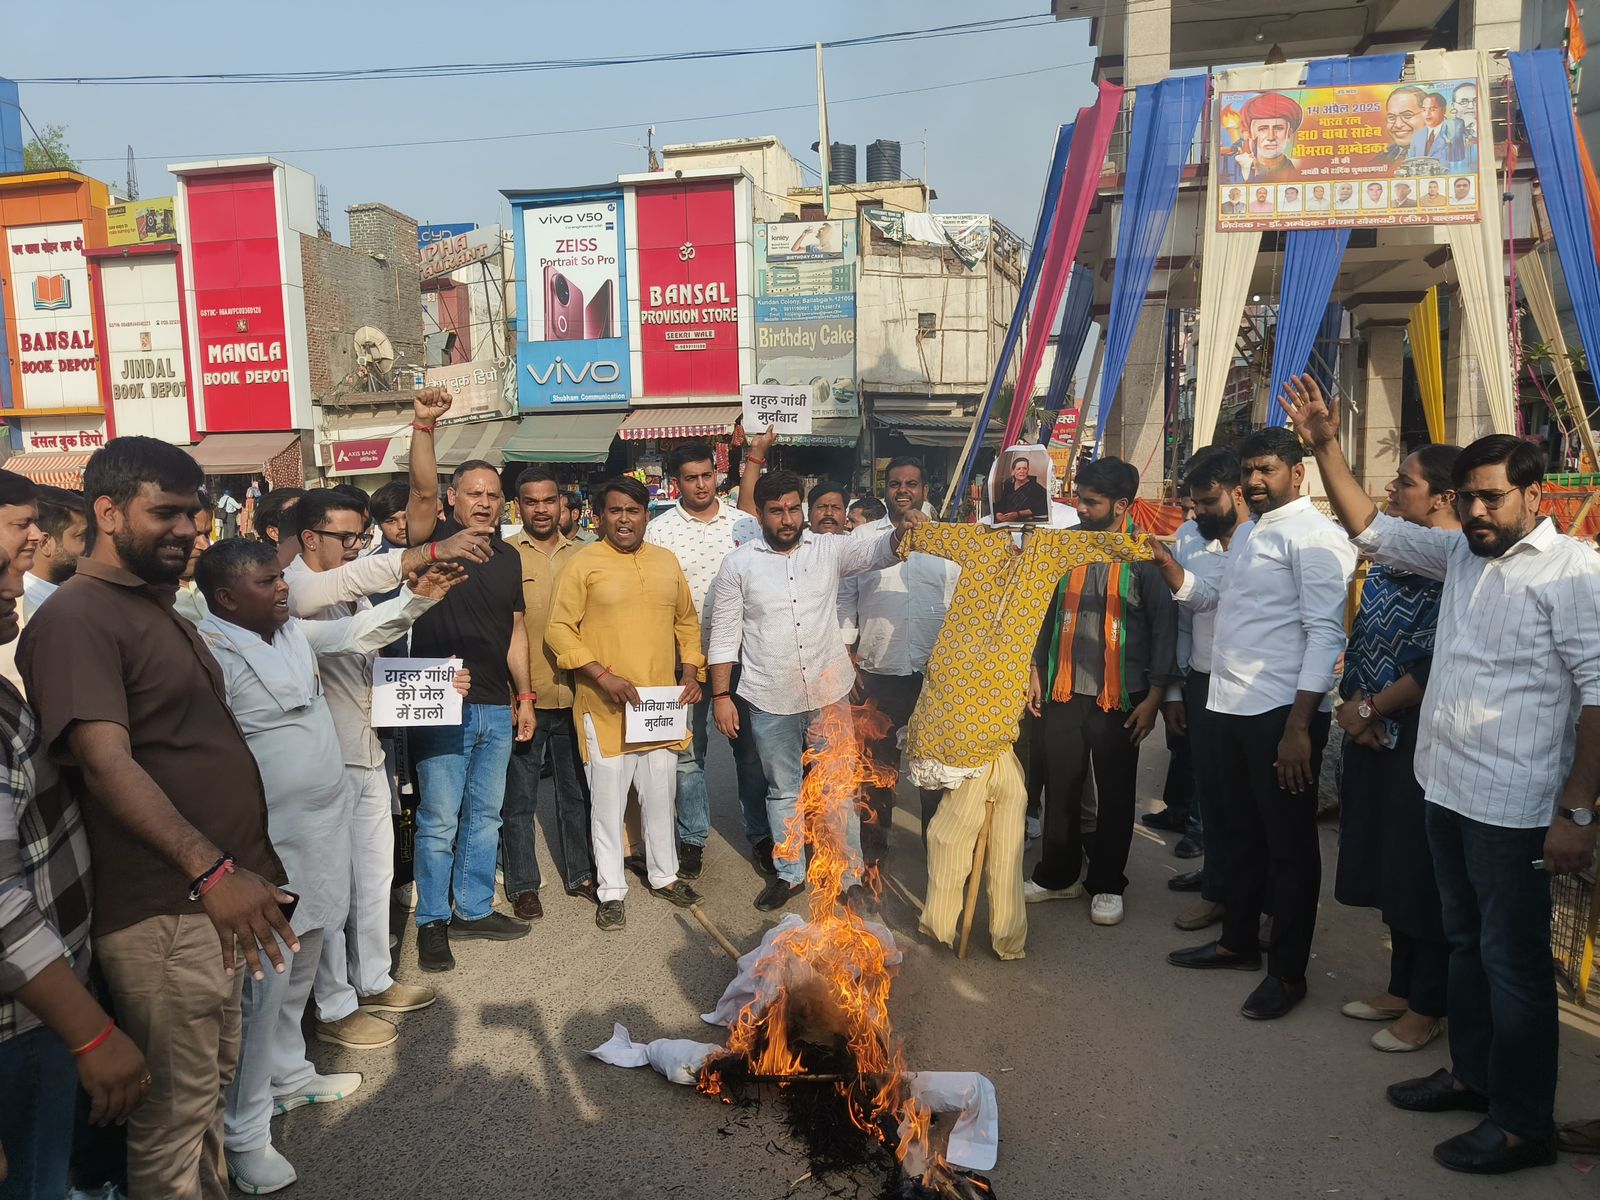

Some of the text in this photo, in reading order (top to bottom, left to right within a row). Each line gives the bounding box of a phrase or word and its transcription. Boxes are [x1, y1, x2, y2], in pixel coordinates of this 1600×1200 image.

[1352, 103, 1380, 112] 2025
[1319, 116, 1361, 126] भारत रत्न
[1322, 128, 1348, 139] बाबा
[1351, 124, 1382, 138] साहेब
[1292, 141, 1389, 157] भीमराव अम्बेडकर
[538, 212, 603, 224] vivo V50
[1284, 218, 1326, 227] अम्बेडकर
[556, 238, 598, 253] ZEISS
[420, 244, 488, 279] AURANT
[540, 255, 615, 268] Portrait So Pro
[650, 282, 730, 307] BANSAL
[758, 298, 780, 306] Kundan
[640, 307, 738, 325] PROVISION STORE
[20, 330, 94, 352] BANSAL
[694, 330, 713, 338] WALE
[759, 324, 855, 351] Birthday Cake
[208, 342, 282, 364] MANGLA
[21, 358, 97, 374] BOOK DEPOT
[120, 358, 176, 380] JINDAL
[526, 355, 620, 384] vivo
[203, 369, 289, 386] BOOK DEPOT
[474, 367, 498, 385] डिपो
[112, 380, 187, 400] BOOK DEPOT
[552, 392, 626, 402] Shubham Communication
[750, 394, 807, 409] राहुल गांधी
[758, 410, 798, 425] मुर्दाबाद
[30, 430, 104, 452] बंसल बुक डिपो
[348, 450, 360, 458] AXIS
[384, 666, 456, 688] राहुल गांधी
[396, 684, 446, 701] को जेल
[396, 703, 444, 720] में डालो
[644, 714, 674, 732] मुर्दाबाद
